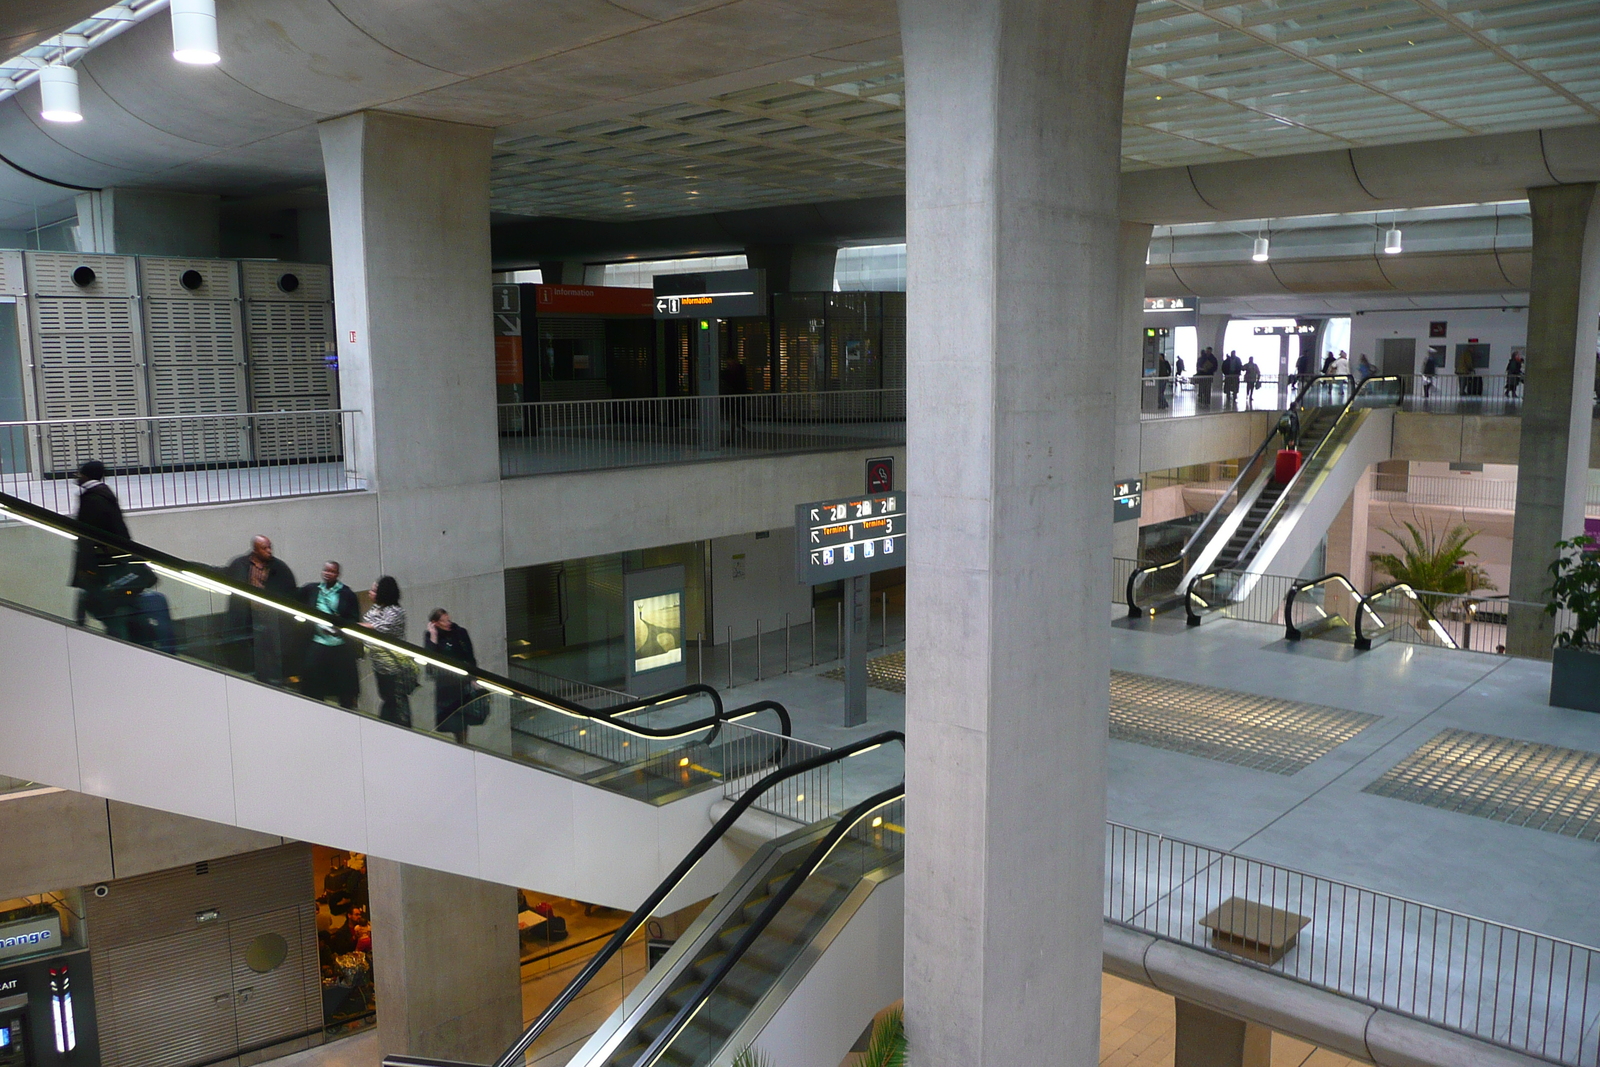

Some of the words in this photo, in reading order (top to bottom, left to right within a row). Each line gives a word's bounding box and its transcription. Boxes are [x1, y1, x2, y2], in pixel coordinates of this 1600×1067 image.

[553, 288, 595, 297] Information
[681, 297, 713, 305] Information
[830, 503, 847, 521] 2D
[881, 496, 896, 514] 2F
[823, 524, 848, 535] Terminal
[848, 524, 854, 540] 1
[862, 518, 886, 529] Terminal
[885, 518, 893, 534] 3
